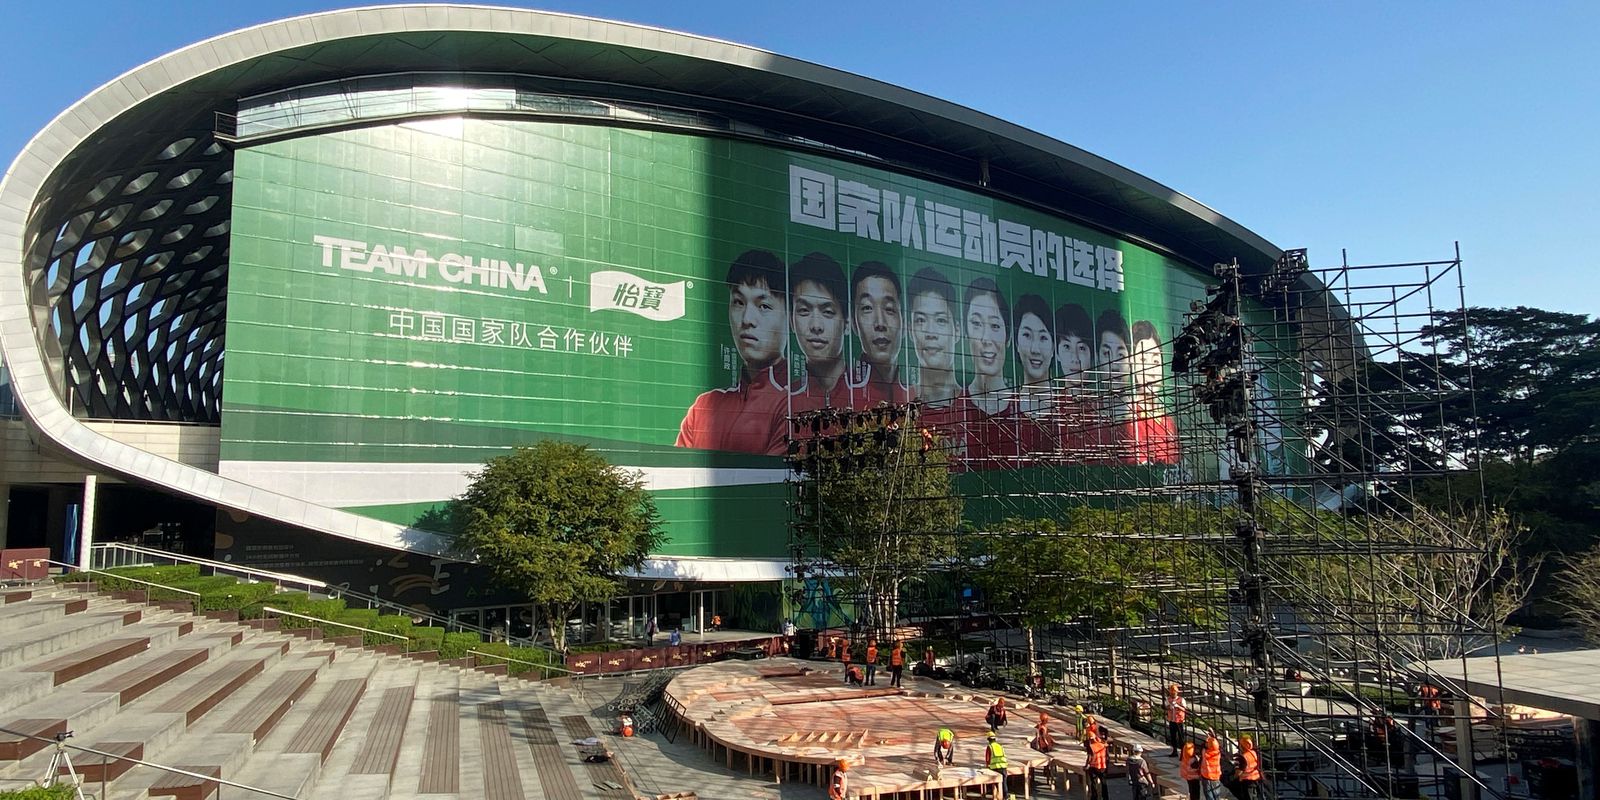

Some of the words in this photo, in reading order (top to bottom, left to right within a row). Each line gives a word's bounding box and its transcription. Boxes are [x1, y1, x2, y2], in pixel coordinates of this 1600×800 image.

[789, 164, 1125, 294] 国家队运动员的选择
[313, 235, 427, 279] TEAM
[438, 253, 548, 295] CHINA
[389, 311, 634, 358] 中国国家队合作伙伴
